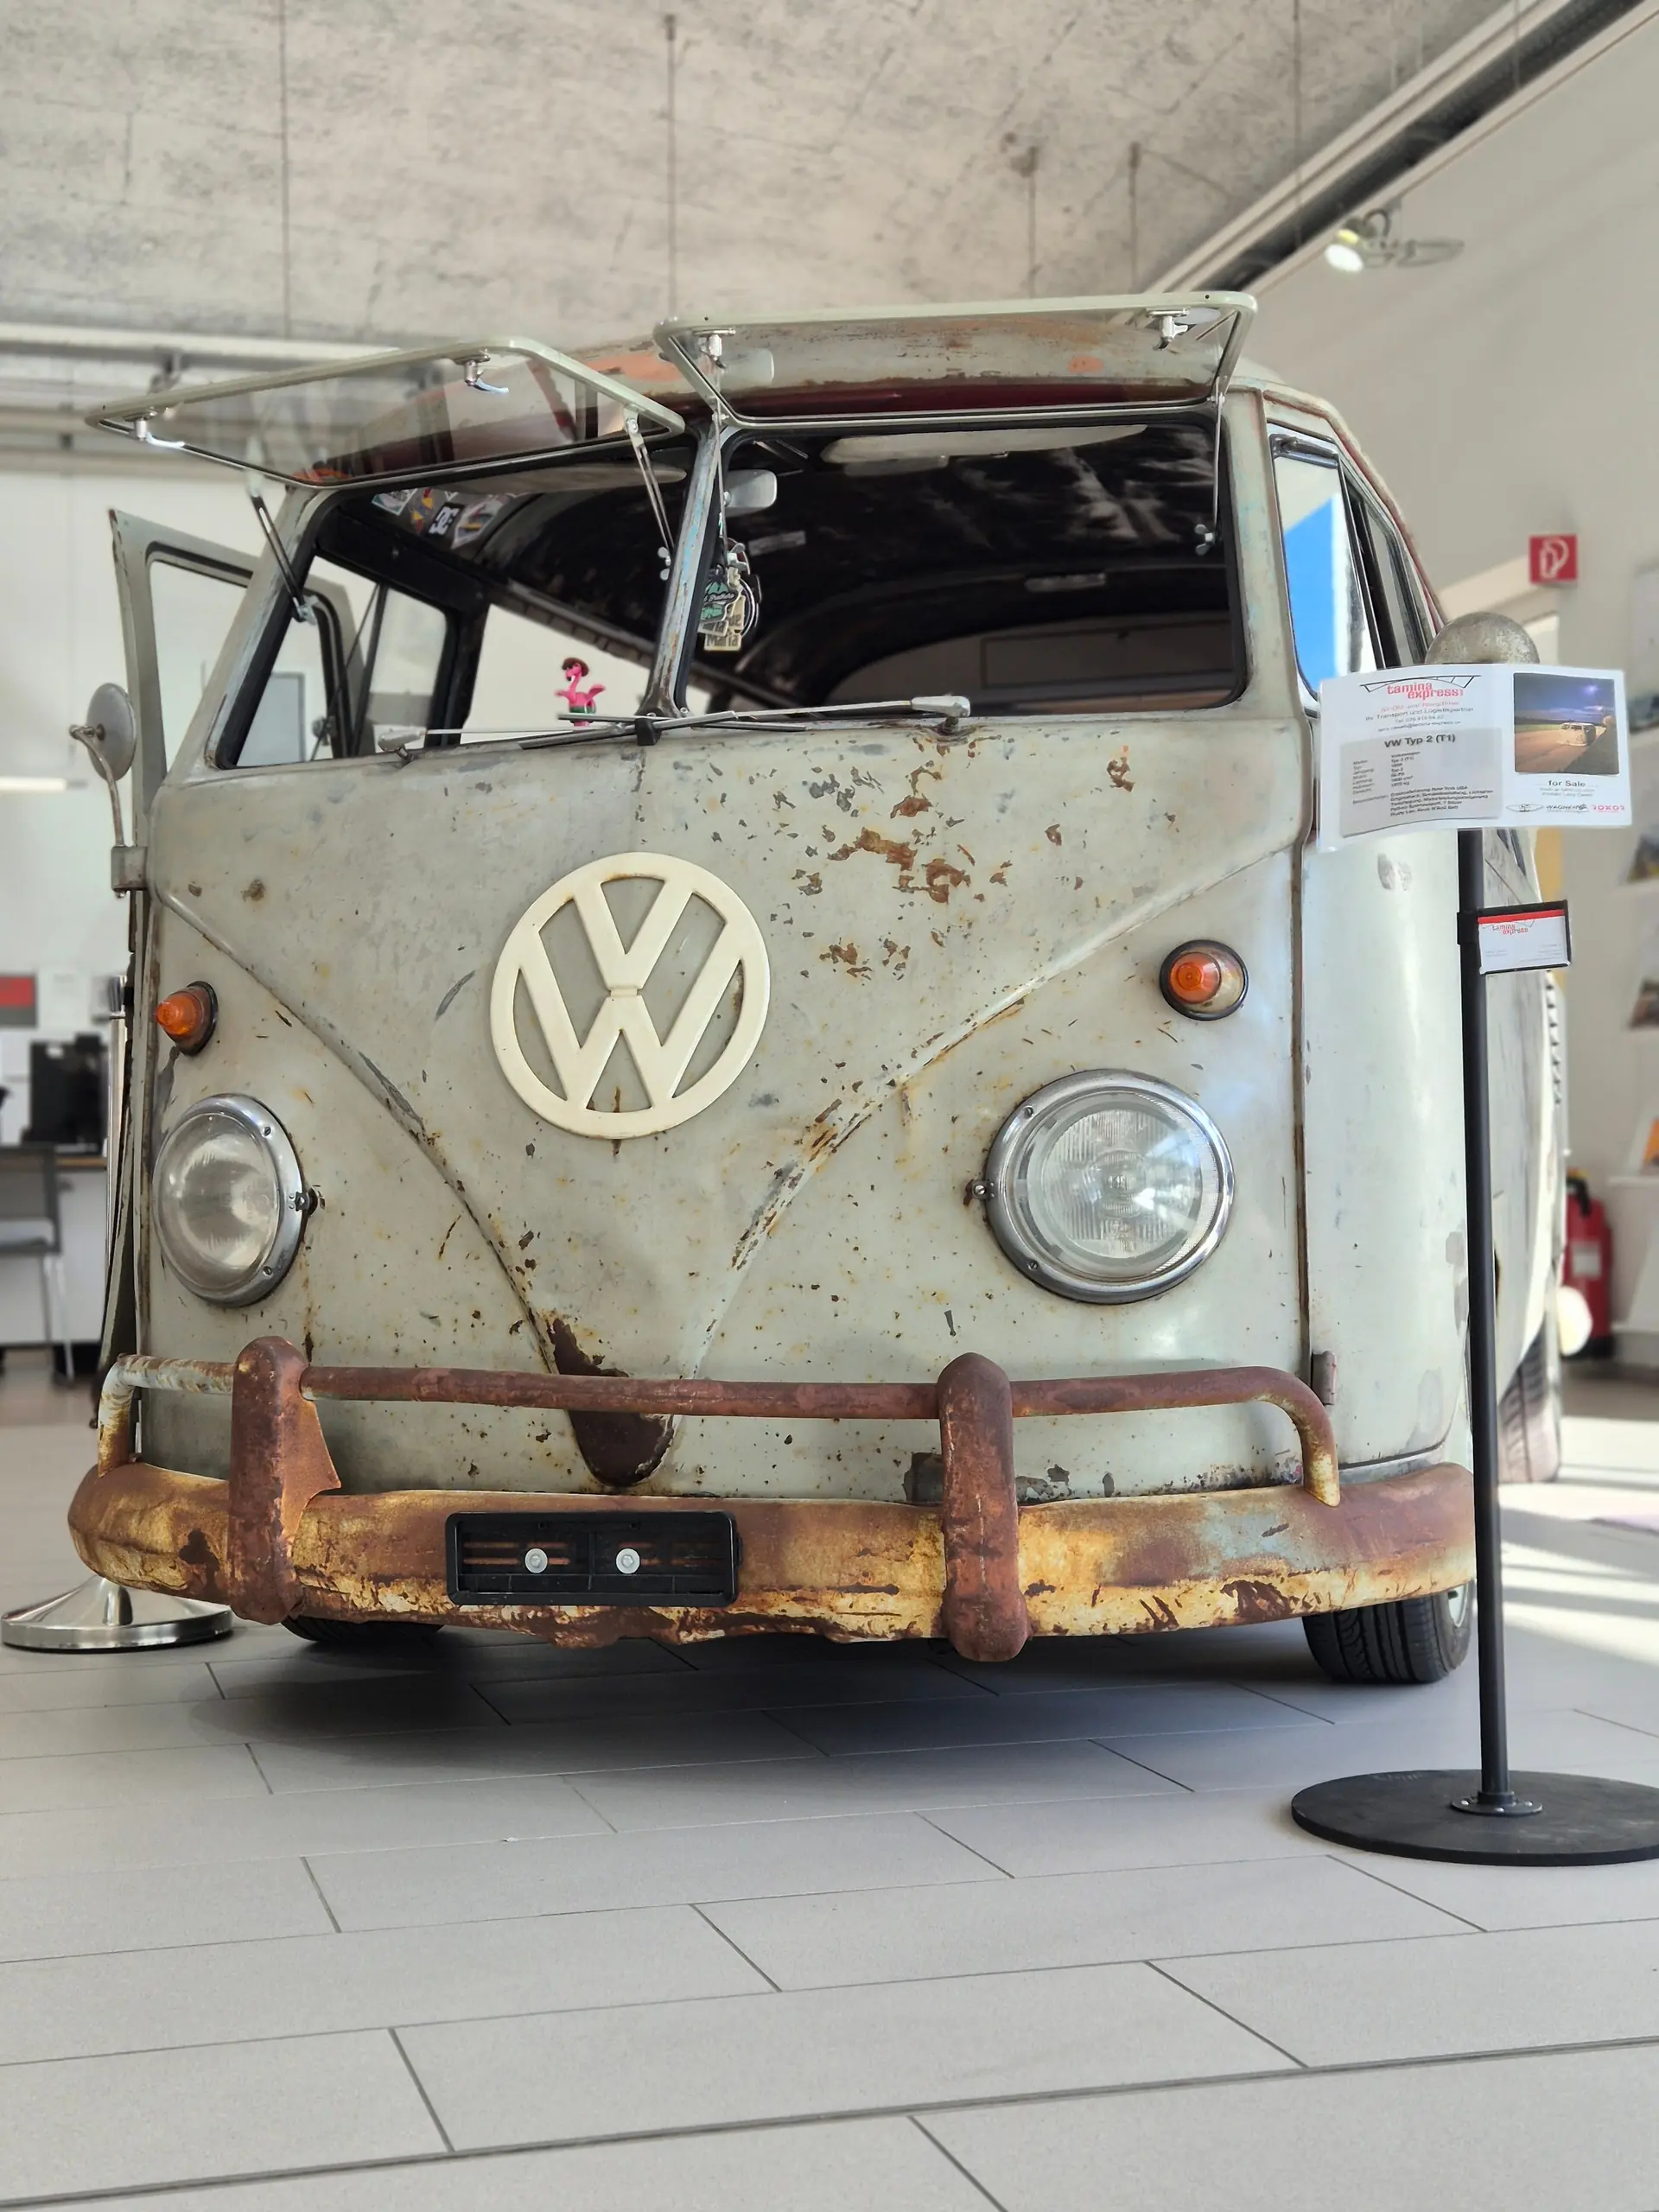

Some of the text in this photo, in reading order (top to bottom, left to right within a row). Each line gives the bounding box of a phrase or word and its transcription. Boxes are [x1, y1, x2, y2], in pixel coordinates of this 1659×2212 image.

[1387, 682, 1433, 695] tamina
[1408, 688, 1459, 700] express
[1384, 739, 1402, 747] VW
[1404, 737, 1423, 746] Typ
[1435, 734, 1456, 743] (T1)
[490, 852, 771, 1140] VW
